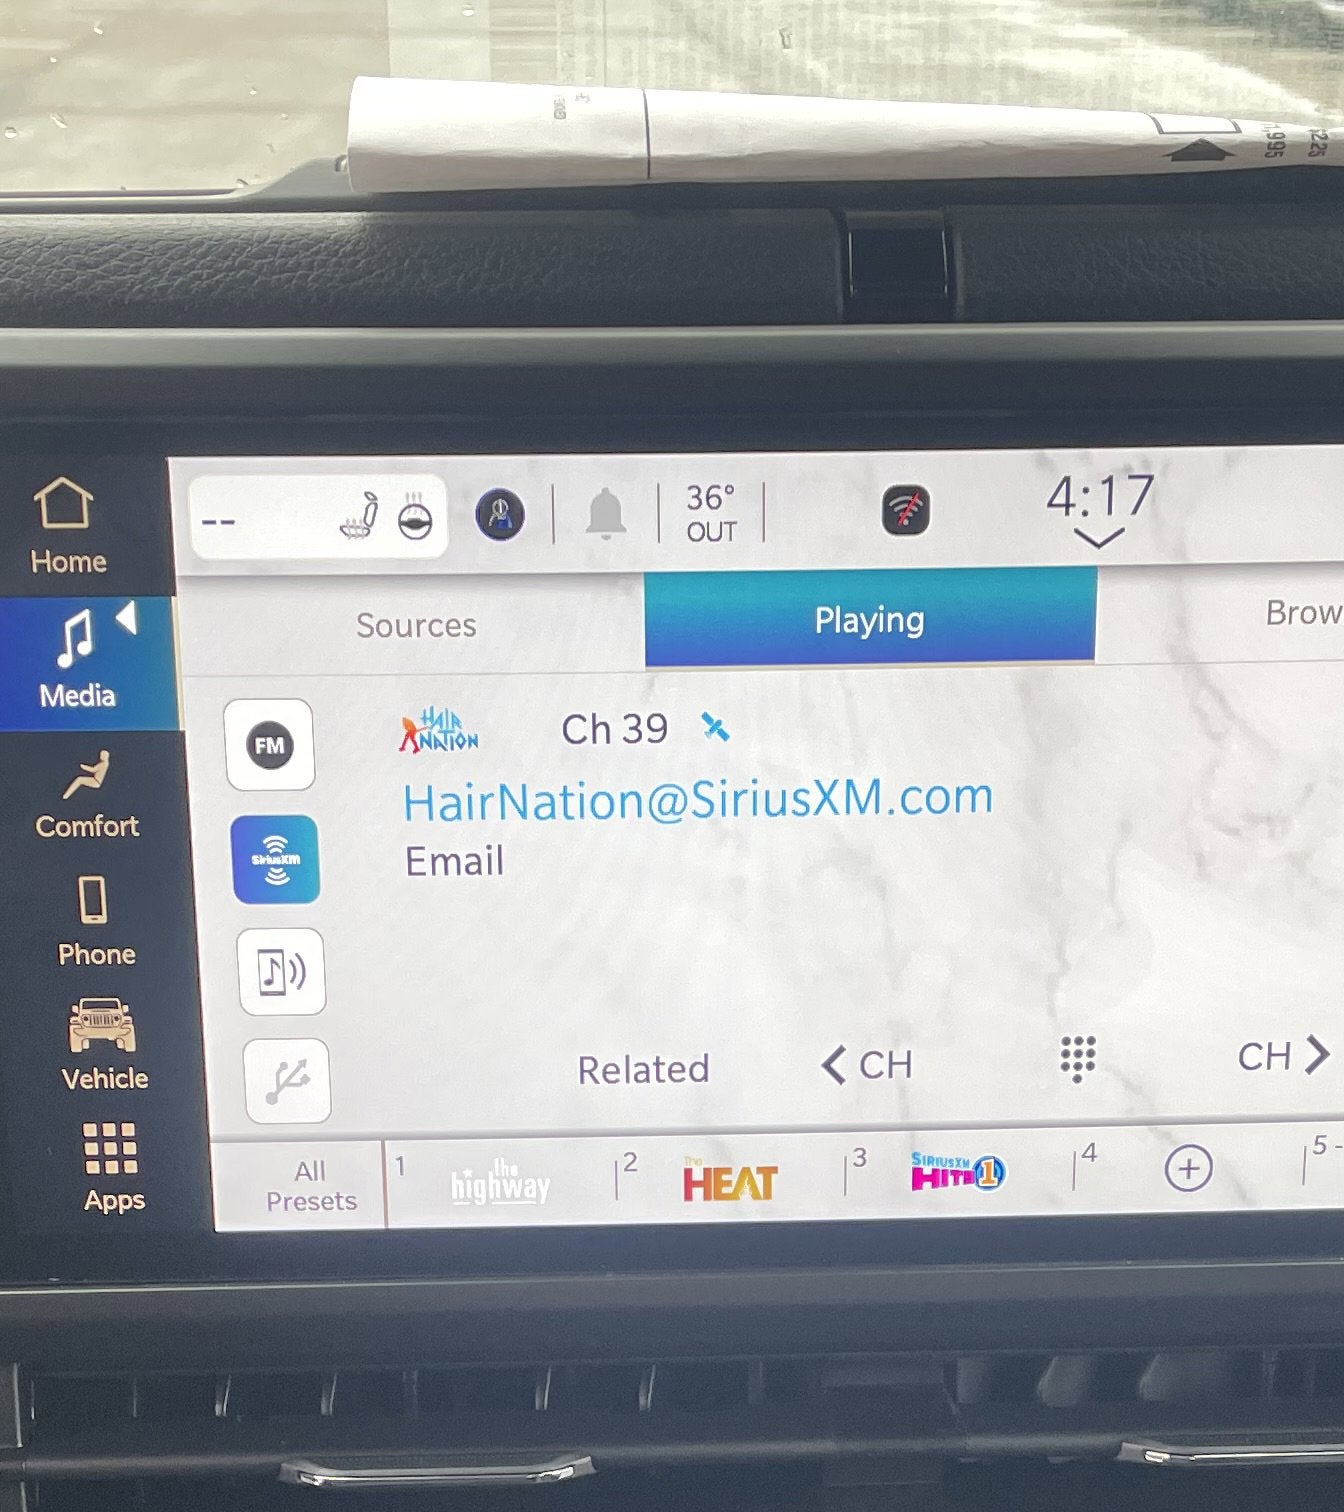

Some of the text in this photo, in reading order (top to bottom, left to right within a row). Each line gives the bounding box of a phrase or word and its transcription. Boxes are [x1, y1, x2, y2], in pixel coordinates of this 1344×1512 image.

[687, 484, 735, 511] 36°
[1046, 474, 1155, 518] 4:17
[687, 520, 738, 543] OUT
[31, 549, 107, 574] Home
[357, 612, 477, 639] Sources
[816, 604, 925, 640] Playing
[39, 682, 117, 708] Media
[562, 712, 668, 745] Ch 39
[252, 734, 287, 759] FM
[405, 778, 992, 825] HairNation@SiriusXM.com
[35, 812, 140, 838] Comfort
[406, 843, 503, 877] Email
[57, 942, 136, 966] Phone
[579, 1052, 709, 1085] Related
[860, 1049, 912, 1080] CH
[1238, 1041, 1291, 1071] CH
[61, 1065, 149, 1090] Vehicle
[852, 1147, 867, 1168] 3
[1081, 1142, 1098, 1163] 4
[1312, 1134, 1327, 1155] 5
[294, 1159, 326, 1182] All
[395, 1155, 404, 1176] 1
[623, 1151, 638, 1172] 2
[452, 1170, 551, 1204] highway
[683, 1166, 778, 1202] HEAT
[83, 1188, 146, 1216] Apps
[267, 1191, 358, 1212] Presets
